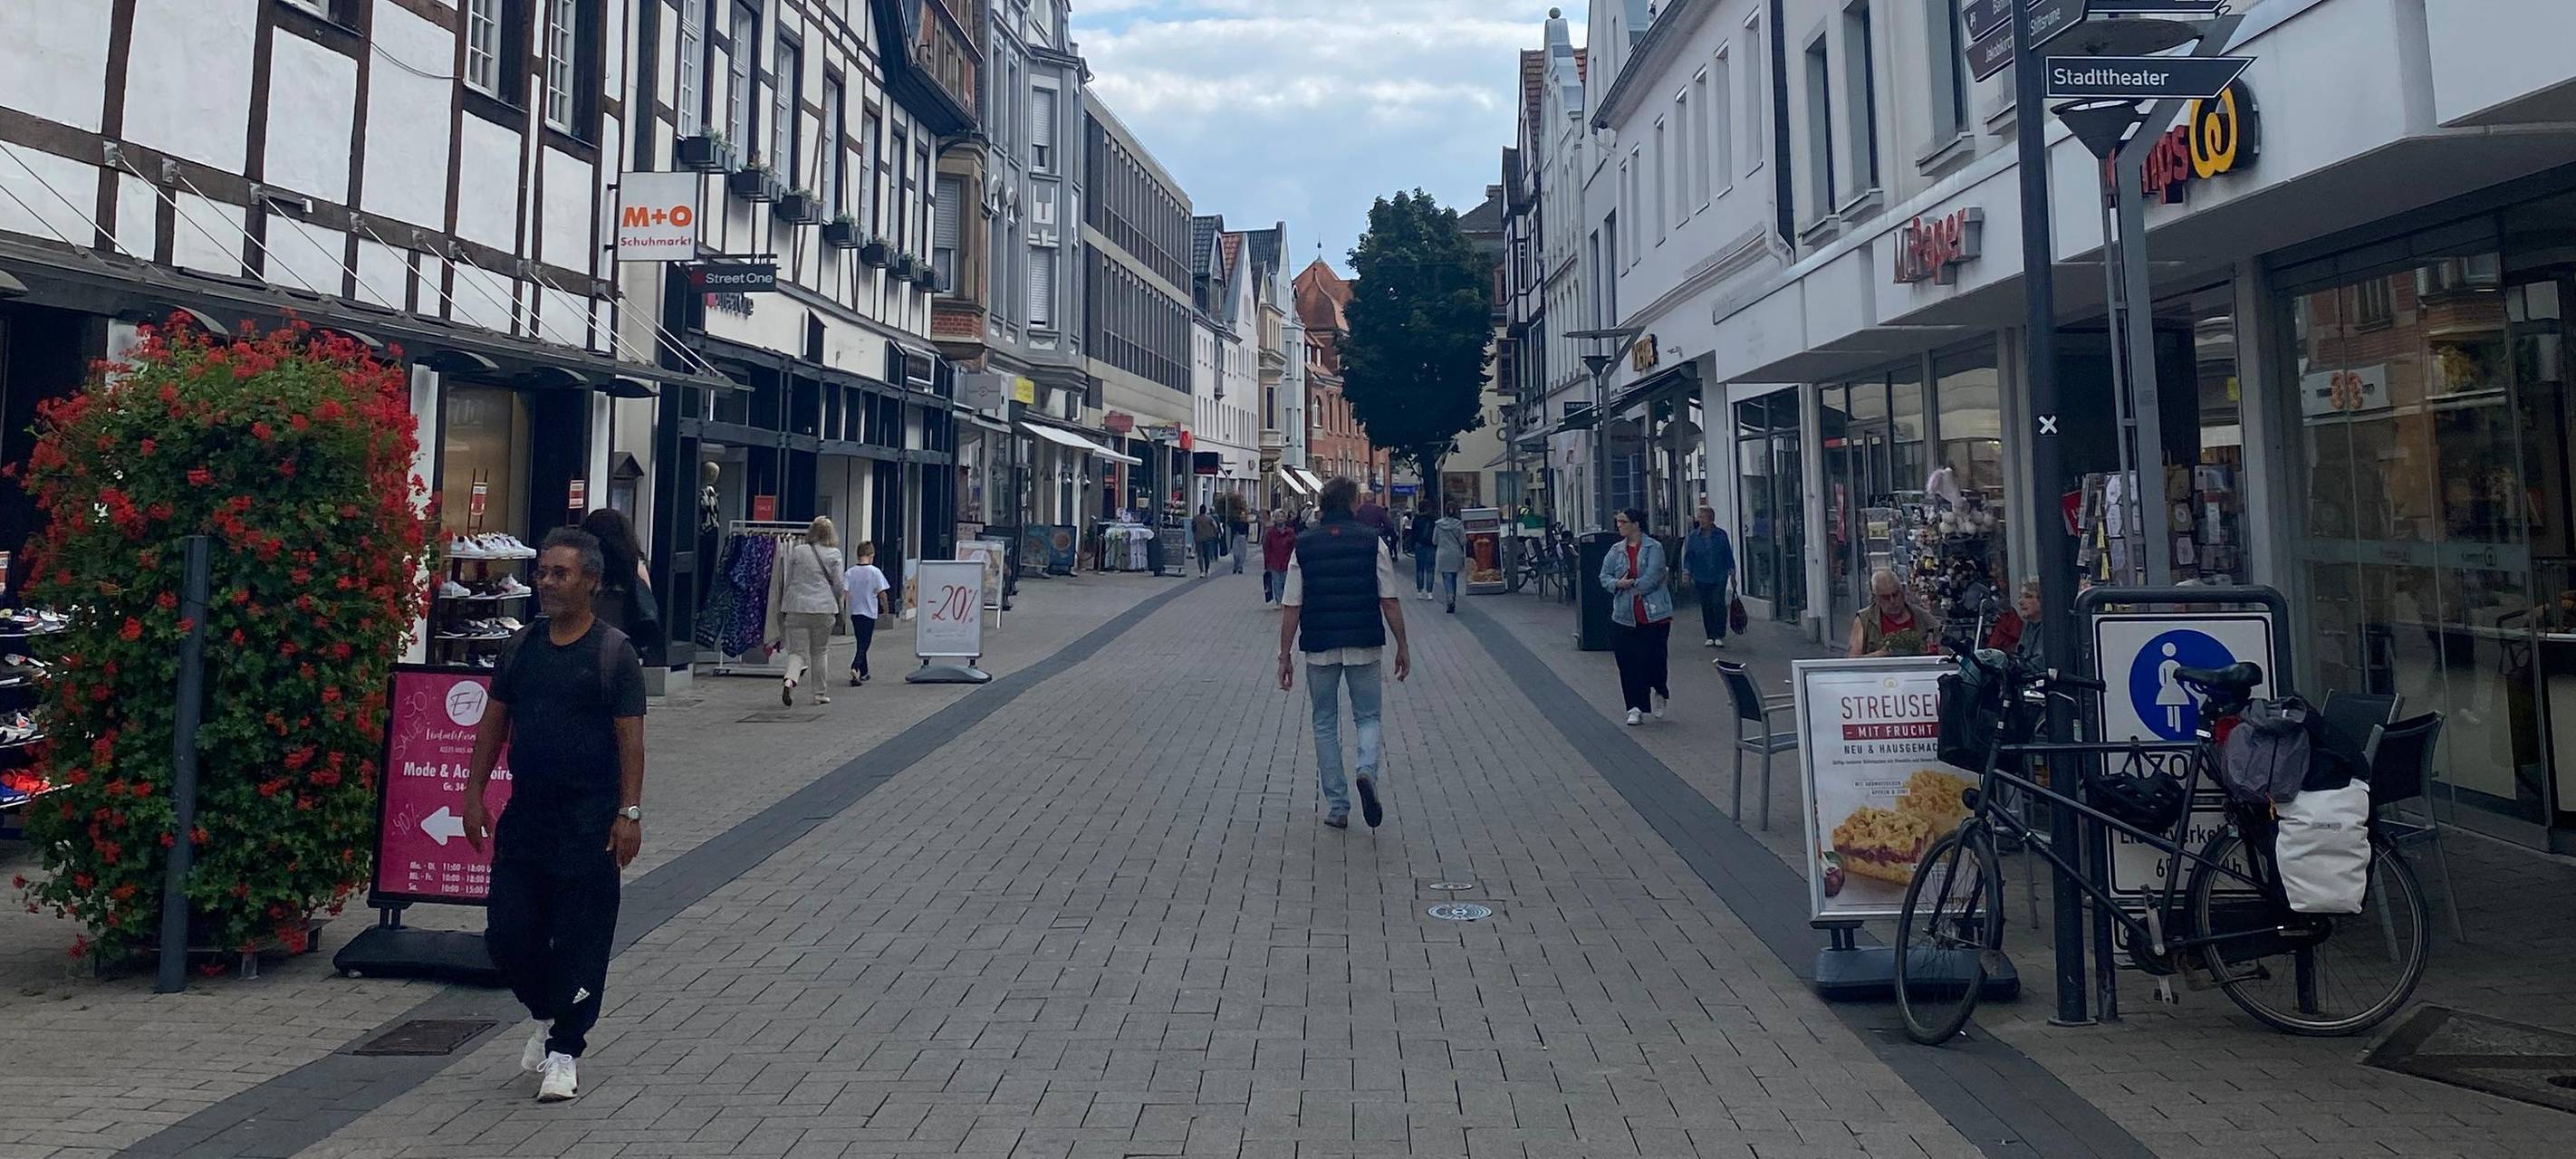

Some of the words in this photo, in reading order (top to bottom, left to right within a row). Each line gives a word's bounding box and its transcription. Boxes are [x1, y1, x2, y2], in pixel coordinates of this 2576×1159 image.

[2053, 68, 2169, 87] Stadttheater
[621, 205, 693, 227] M+O
[620, 235, 692, 247] Schuhmarkt
[705, 273, 745, 284] Street
[747, 273, 774, 284] One
[927, 585, 978, 624] -20%
[1858, 726, 1879, 737] MIT
[1886, 724, 1933, 737] FRUCHT
[1844, 744, 1863, 754] NEU
[1868, 744, 1874, 754] &
[1879, 742, 1938, 753] HAUSGEMAC
[403, 761, 437, 777] Mode
[439, 763, 449, 778] &
